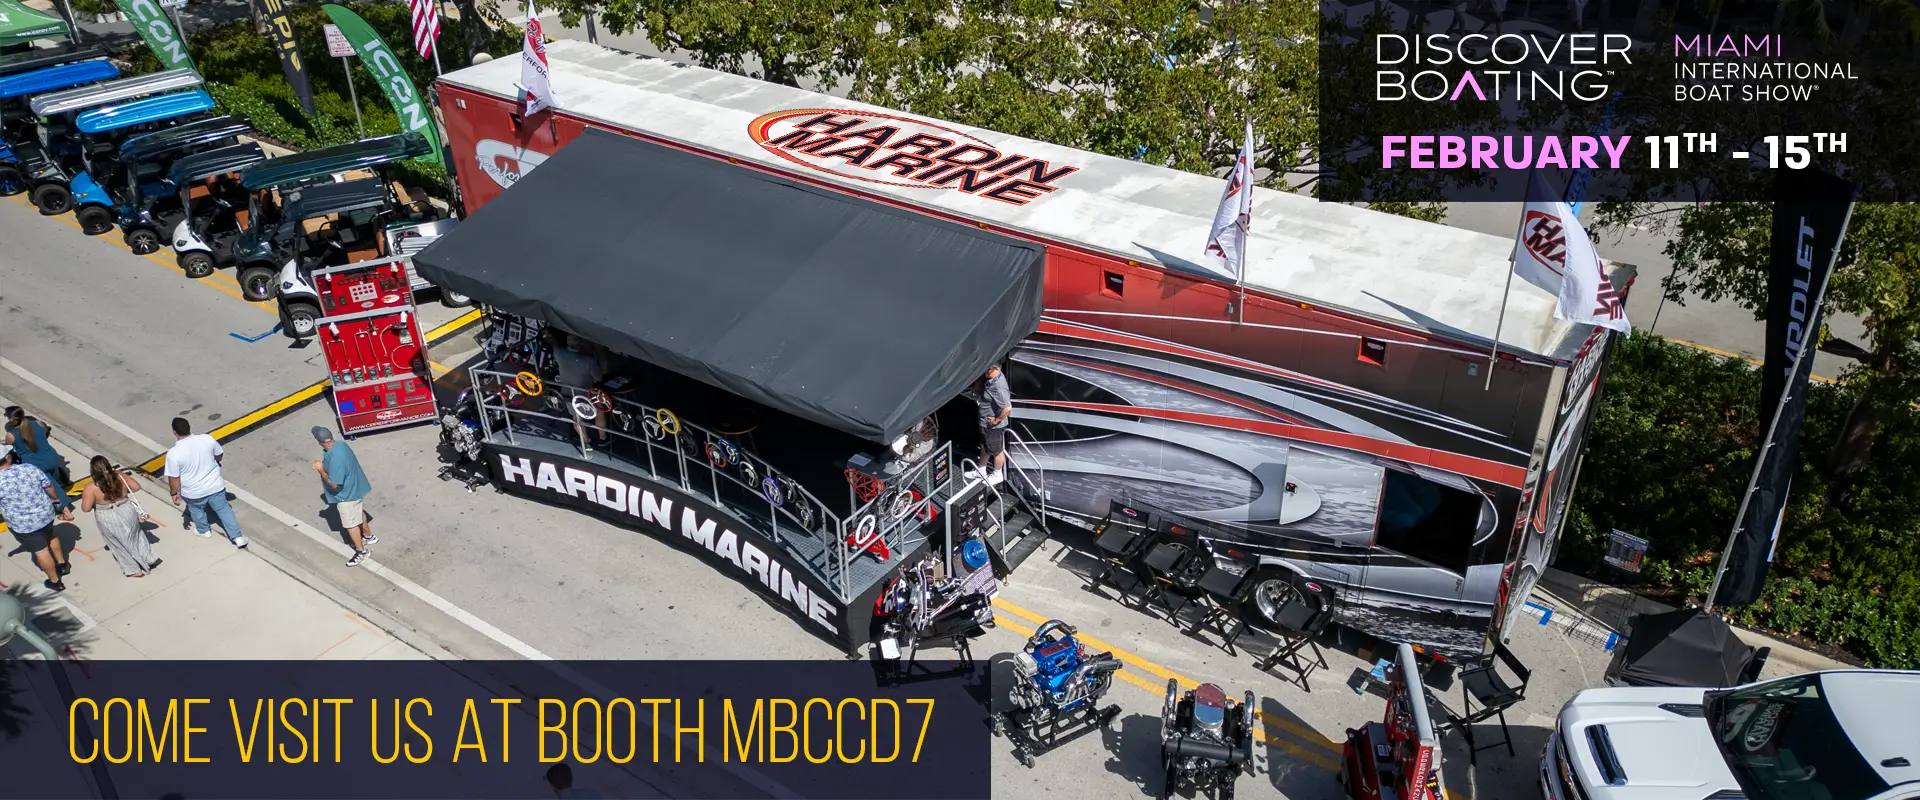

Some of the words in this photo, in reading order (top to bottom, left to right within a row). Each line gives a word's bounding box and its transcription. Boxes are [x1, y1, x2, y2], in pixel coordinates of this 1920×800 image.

[363, 39, 428, 131] ICON
[522, 51, 548, 80] ERFOR
[768, 131, 1058, 206] MARINE
[795, 111, 1081, 186] HARDIN
[1785, 216, 1815, 379] VROLET
[499, 453, 673, 531] HARDIN
[681, 507, 839, 635] MARINE
